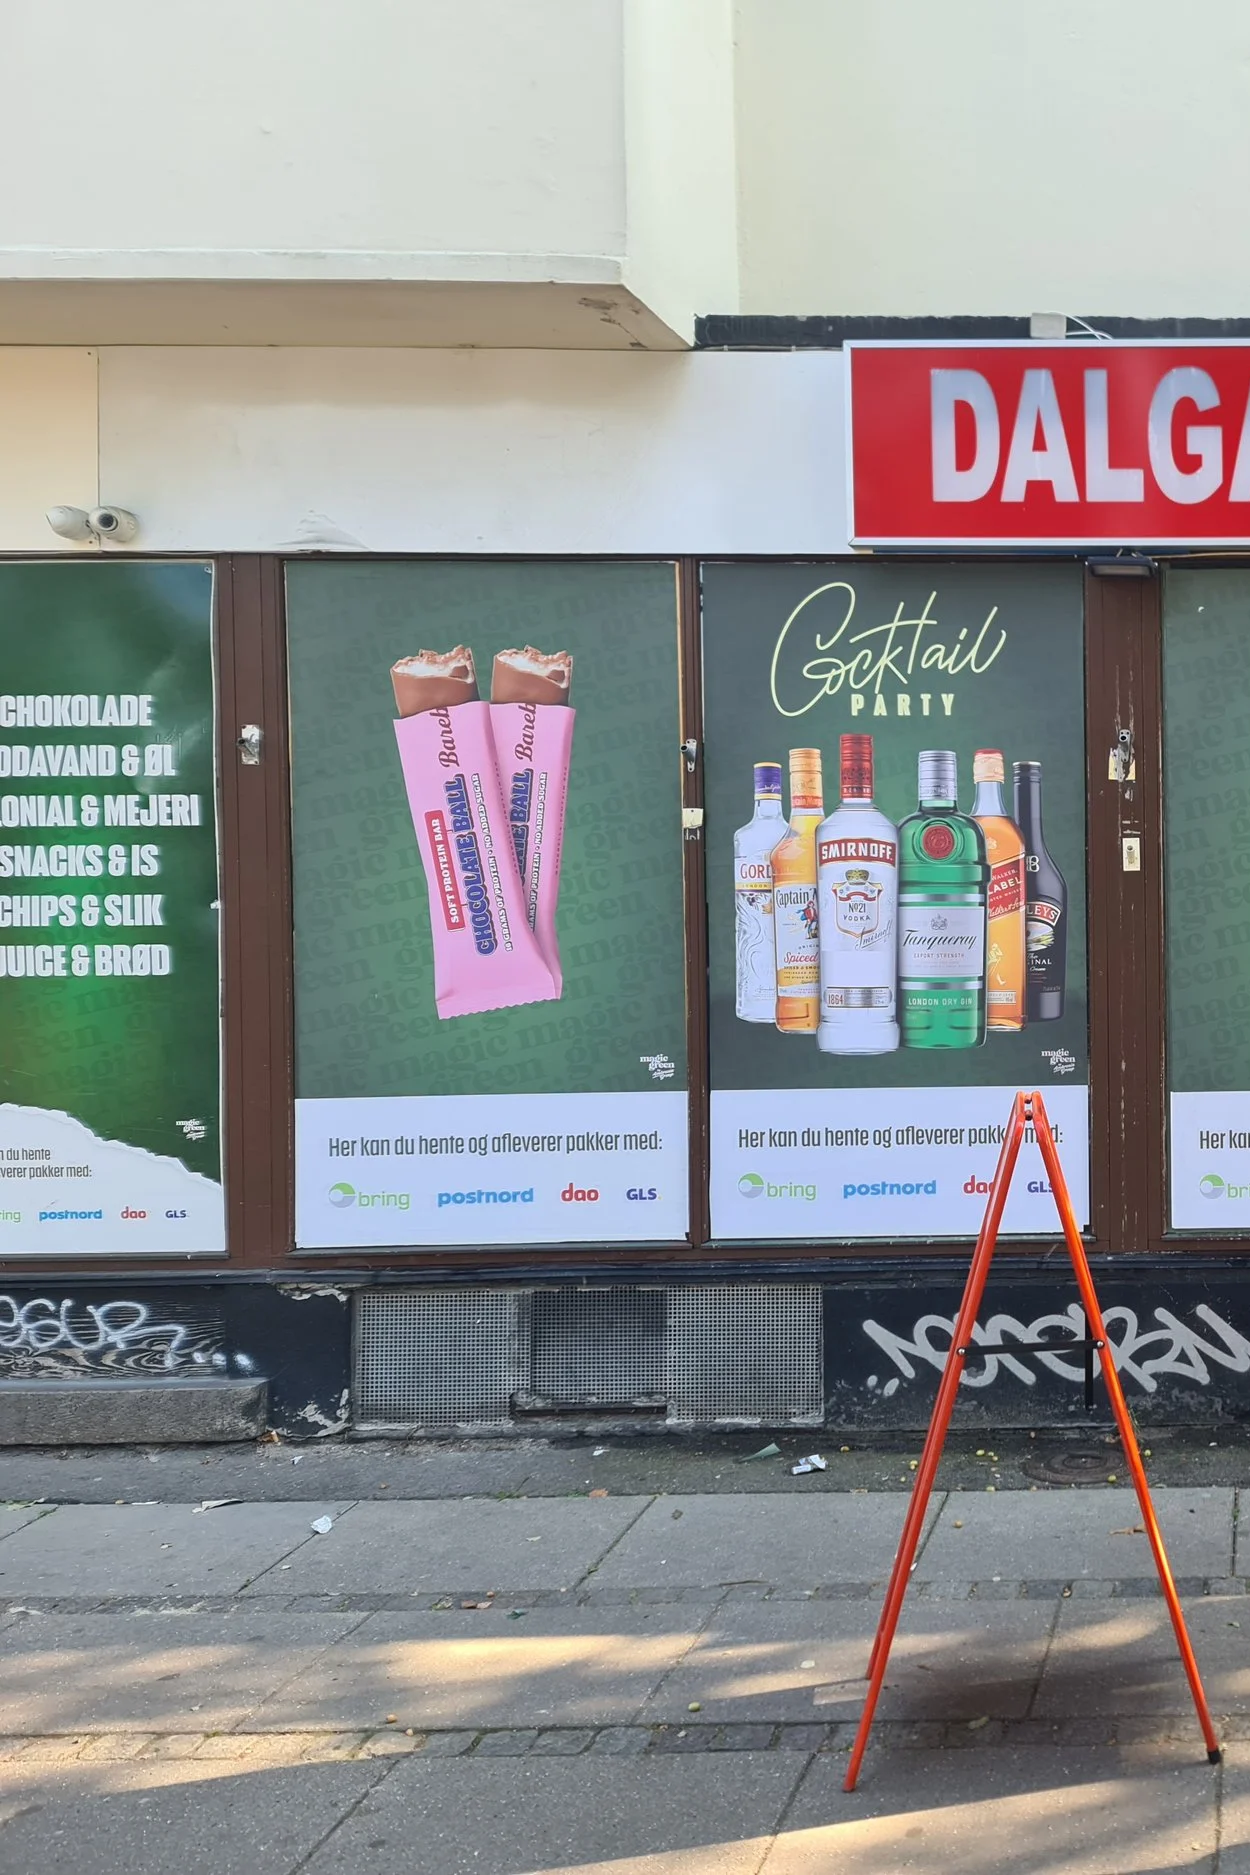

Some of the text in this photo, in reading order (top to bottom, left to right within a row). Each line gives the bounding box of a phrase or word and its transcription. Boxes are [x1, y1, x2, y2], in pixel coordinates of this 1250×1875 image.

[771, 582, 1007, 717] Cocktail
[0, 695, 153, 727] CHOKOLADE
[851, 693, 955, 716] PARTY
[122, 744, 140, 776] &
[144, 744, 176, 776] ØL
[471, 773, 485, 804] SUGAR
[509, 768, 534, 824] BALL
[537, 772, 548, 802] SUGAR
[0, 794, 200, 827] ONIAL & MEJERI
[478, 804, 491, 834] ADDED
[535, 801, 546, 831] ADDED
[482, 835, 493, 849] NO
[534, 831, 543, 845] NO
[0, 844, 158, 877] SNACKS & IS
[443, 772, 498, 956] CHOCOLATE BALL
[821, 843, 893, 861] SMIRNOFF
[431, 818, 460, 923] SOFT PROTEIN BAR
[488, 856, 503, 895] PROTEIN
[531, 852, 541, 889] PROTEIN
[0, 894, 163, 927] CHIPS & SLIK
[776, 888, 809, 908] Captain
[498, 909, 512, 940] GRAMS
[902, 929, 977, 950] Tanqueray
[71, 944, 89, 977] &
[95, 944, 170, 977] BRØD
[784, 951, 818, 964] Spiced
[640, 1053, 668, 1063] magic
[649, 1061, 675, 1071] green
[1041, 1048, 1069, 1058] magic
[1050, 1055, 1076, 1065] green
[328, 1130, 663, 1157] Her kan du hente og afleverer pakker med:
[738, 1124, 1063, 1149] Her kan du hente og afleverer pakk md:
[1199, 1129, 1226, 1150] Her
[6, 1148, 20, 1161] du
[21, 1148, 51, 1161] hente
[29, 1165, 65, 1180] pakker
[66, 1165, 92, 1178] med:
[358, 1183, 657, 1210] bring postnord dao GLS
[766, 1181, 817, 1201] bring
[843, 1180, 937, 1199] postnord
[39, 1206, 187, 1222] postnord dao GLS
